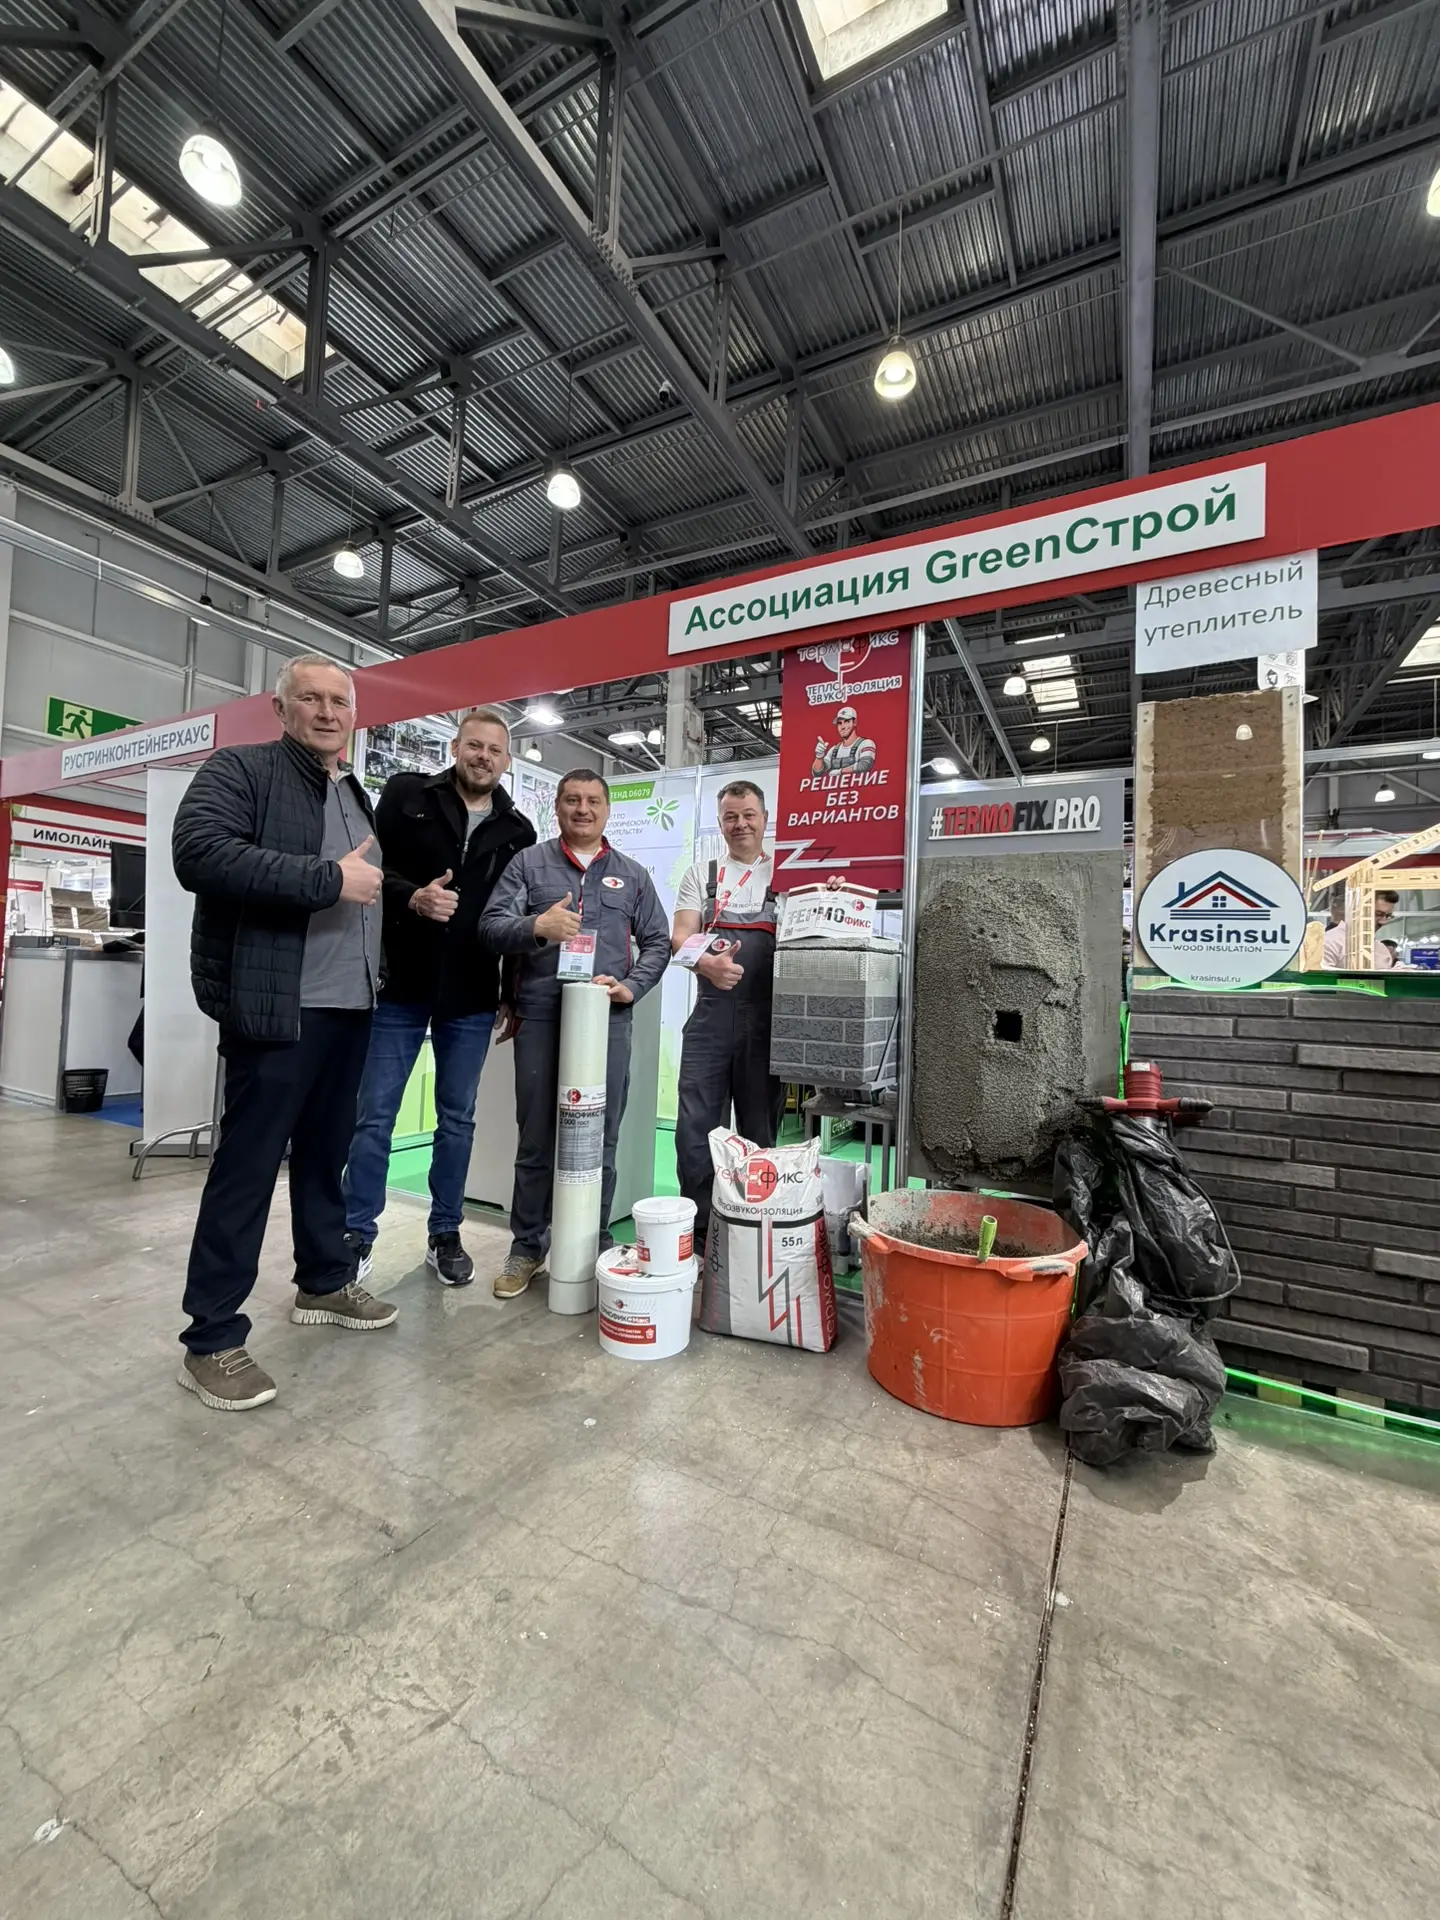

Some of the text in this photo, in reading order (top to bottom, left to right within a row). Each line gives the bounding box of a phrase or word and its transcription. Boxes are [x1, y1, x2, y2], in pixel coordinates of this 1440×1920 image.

[684, 484, 1238, 635] Ассоциация GreenСтрой
[1144, 559, 1304, 610] Древесный
[1144, 604, 1303, 646] утеплитель
[63, 723, 210, 772] РУСГРИНКОНТЕЙНЕРХАУС
[800, 770, 890, 792] РЕШЕНИЕ
[609, 790, 628, 799] ТЕНД
[826, 791, 859, 807] БЕЗ
[788, 805, 900, 827] ВАРИАНТОВ
[931, 795, 1101, 838] #TERMOFIX.PRO
[33, 828, 112, 850] ИМОЛАЙН
[1150, 923, 1290, 944] Krasinsul
[1173, 944, 1262, 953] WOOD INSULATION
[1190, 974, 1241, 983] krasinsul.ru
